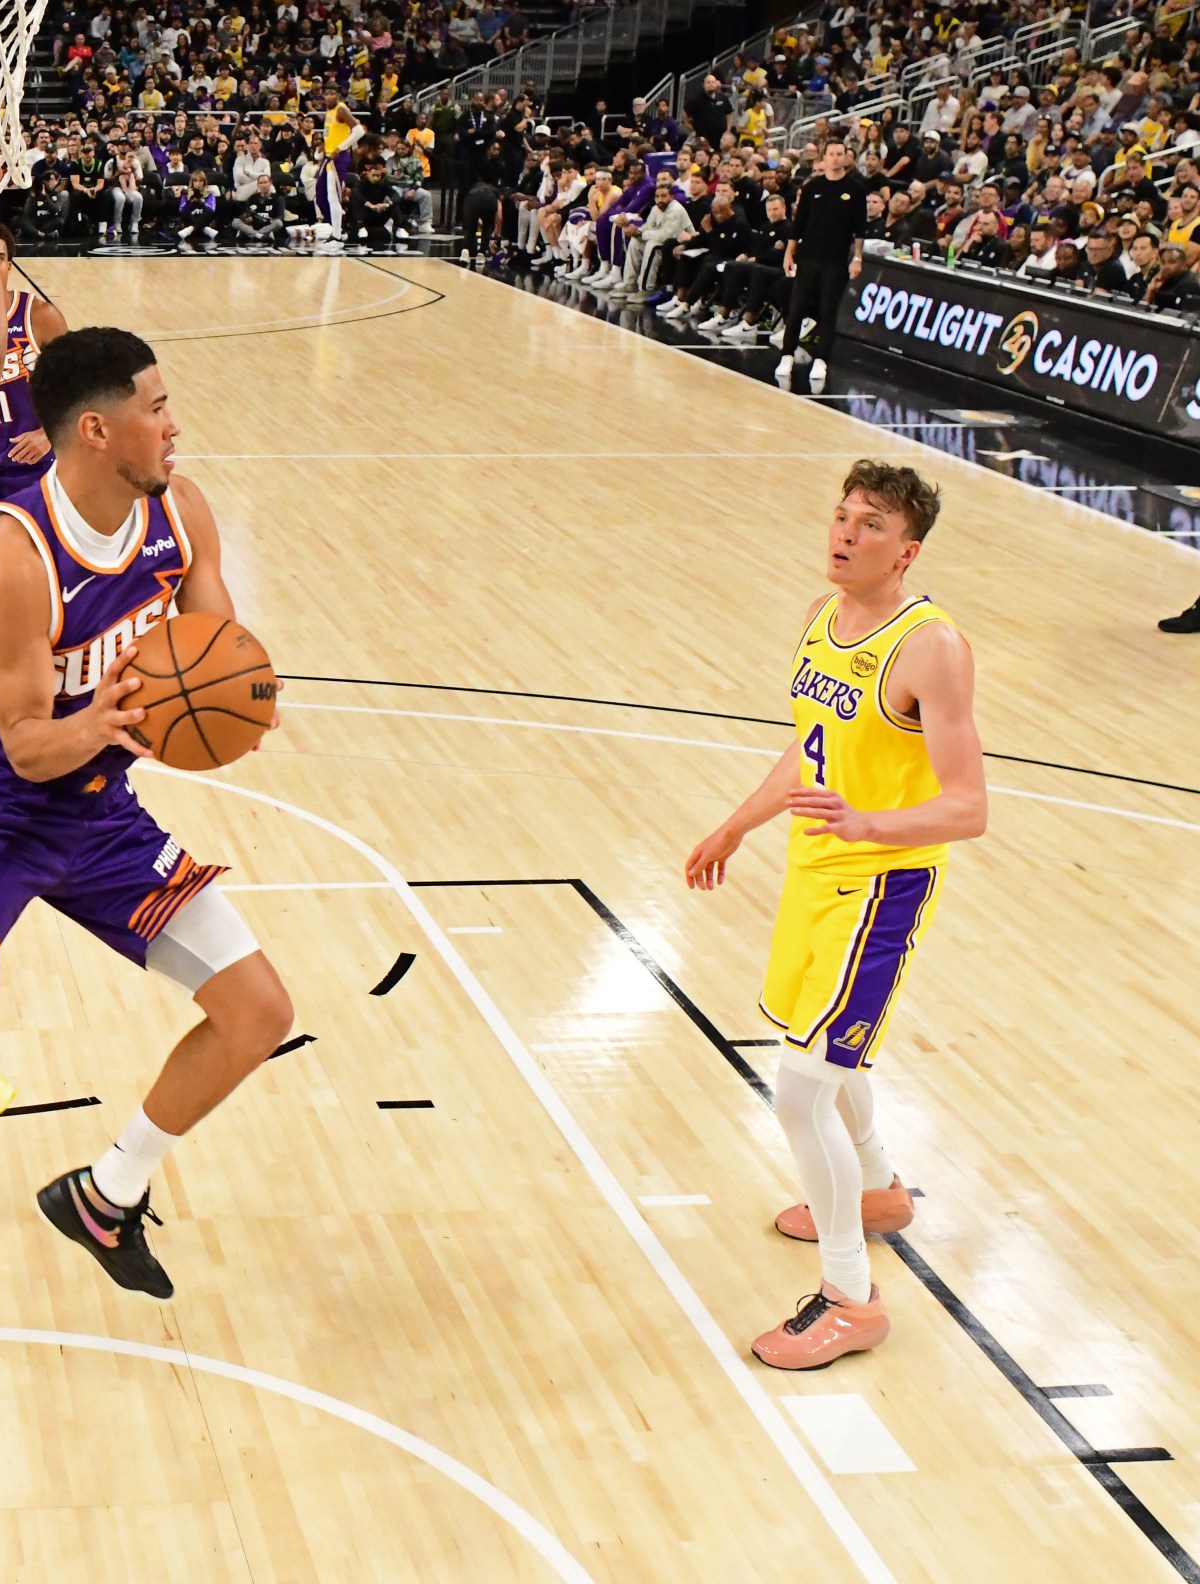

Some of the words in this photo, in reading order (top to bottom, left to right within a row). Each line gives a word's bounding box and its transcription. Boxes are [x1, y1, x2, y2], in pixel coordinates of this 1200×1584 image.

[7, 325, 23, 334] yPal
[854, 282, 1004, 357] SPOTLIGHT
[1033, 329, 1159, 402] CASINO
[790, 656, 864, 721] LAKERS
[853, 655, 876, 672] bibigo
[803, 723, 826, 786] 4
